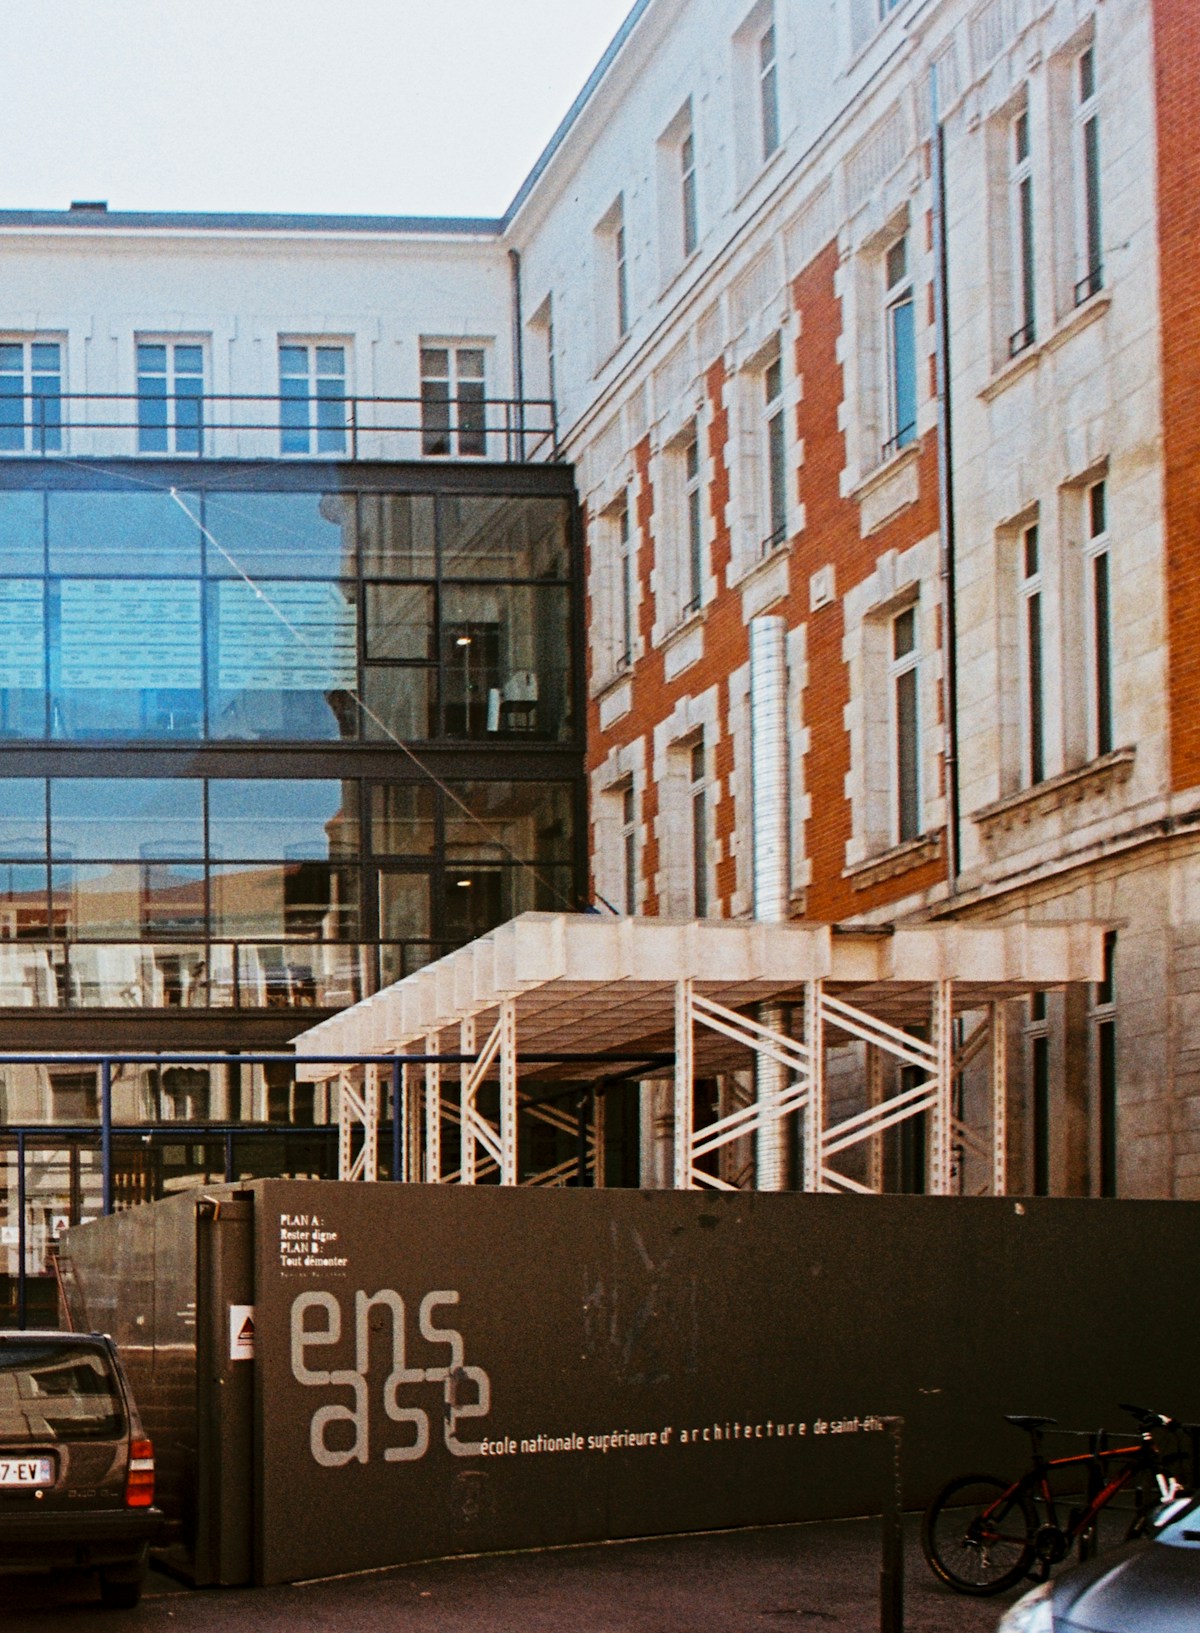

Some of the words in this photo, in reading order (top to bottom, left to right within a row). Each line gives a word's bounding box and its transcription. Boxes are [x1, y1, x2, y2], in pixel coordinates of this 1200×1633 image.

[280, 1214, 309, 1226] PLAN
[280, 1228, 310, 1240] Rester
[312, 1228, 338, 1242] digne
[280, 1242, 309, 1253] PLAN
[280, 1254, 302, 1266] Tout
[303, 1254, 348, 1267] démonter
[290, 1288, 465, 1386] ens
[310, 1366, 491, 1467] ase
[480, 1436, 517, 1456] école
[520, 1432, 585, 1454] nationale
[587, 1429, 658, 1454] supérieure
[679, 1420, 807, 1444] architecture
[813, 1418, 828, 1435] de
